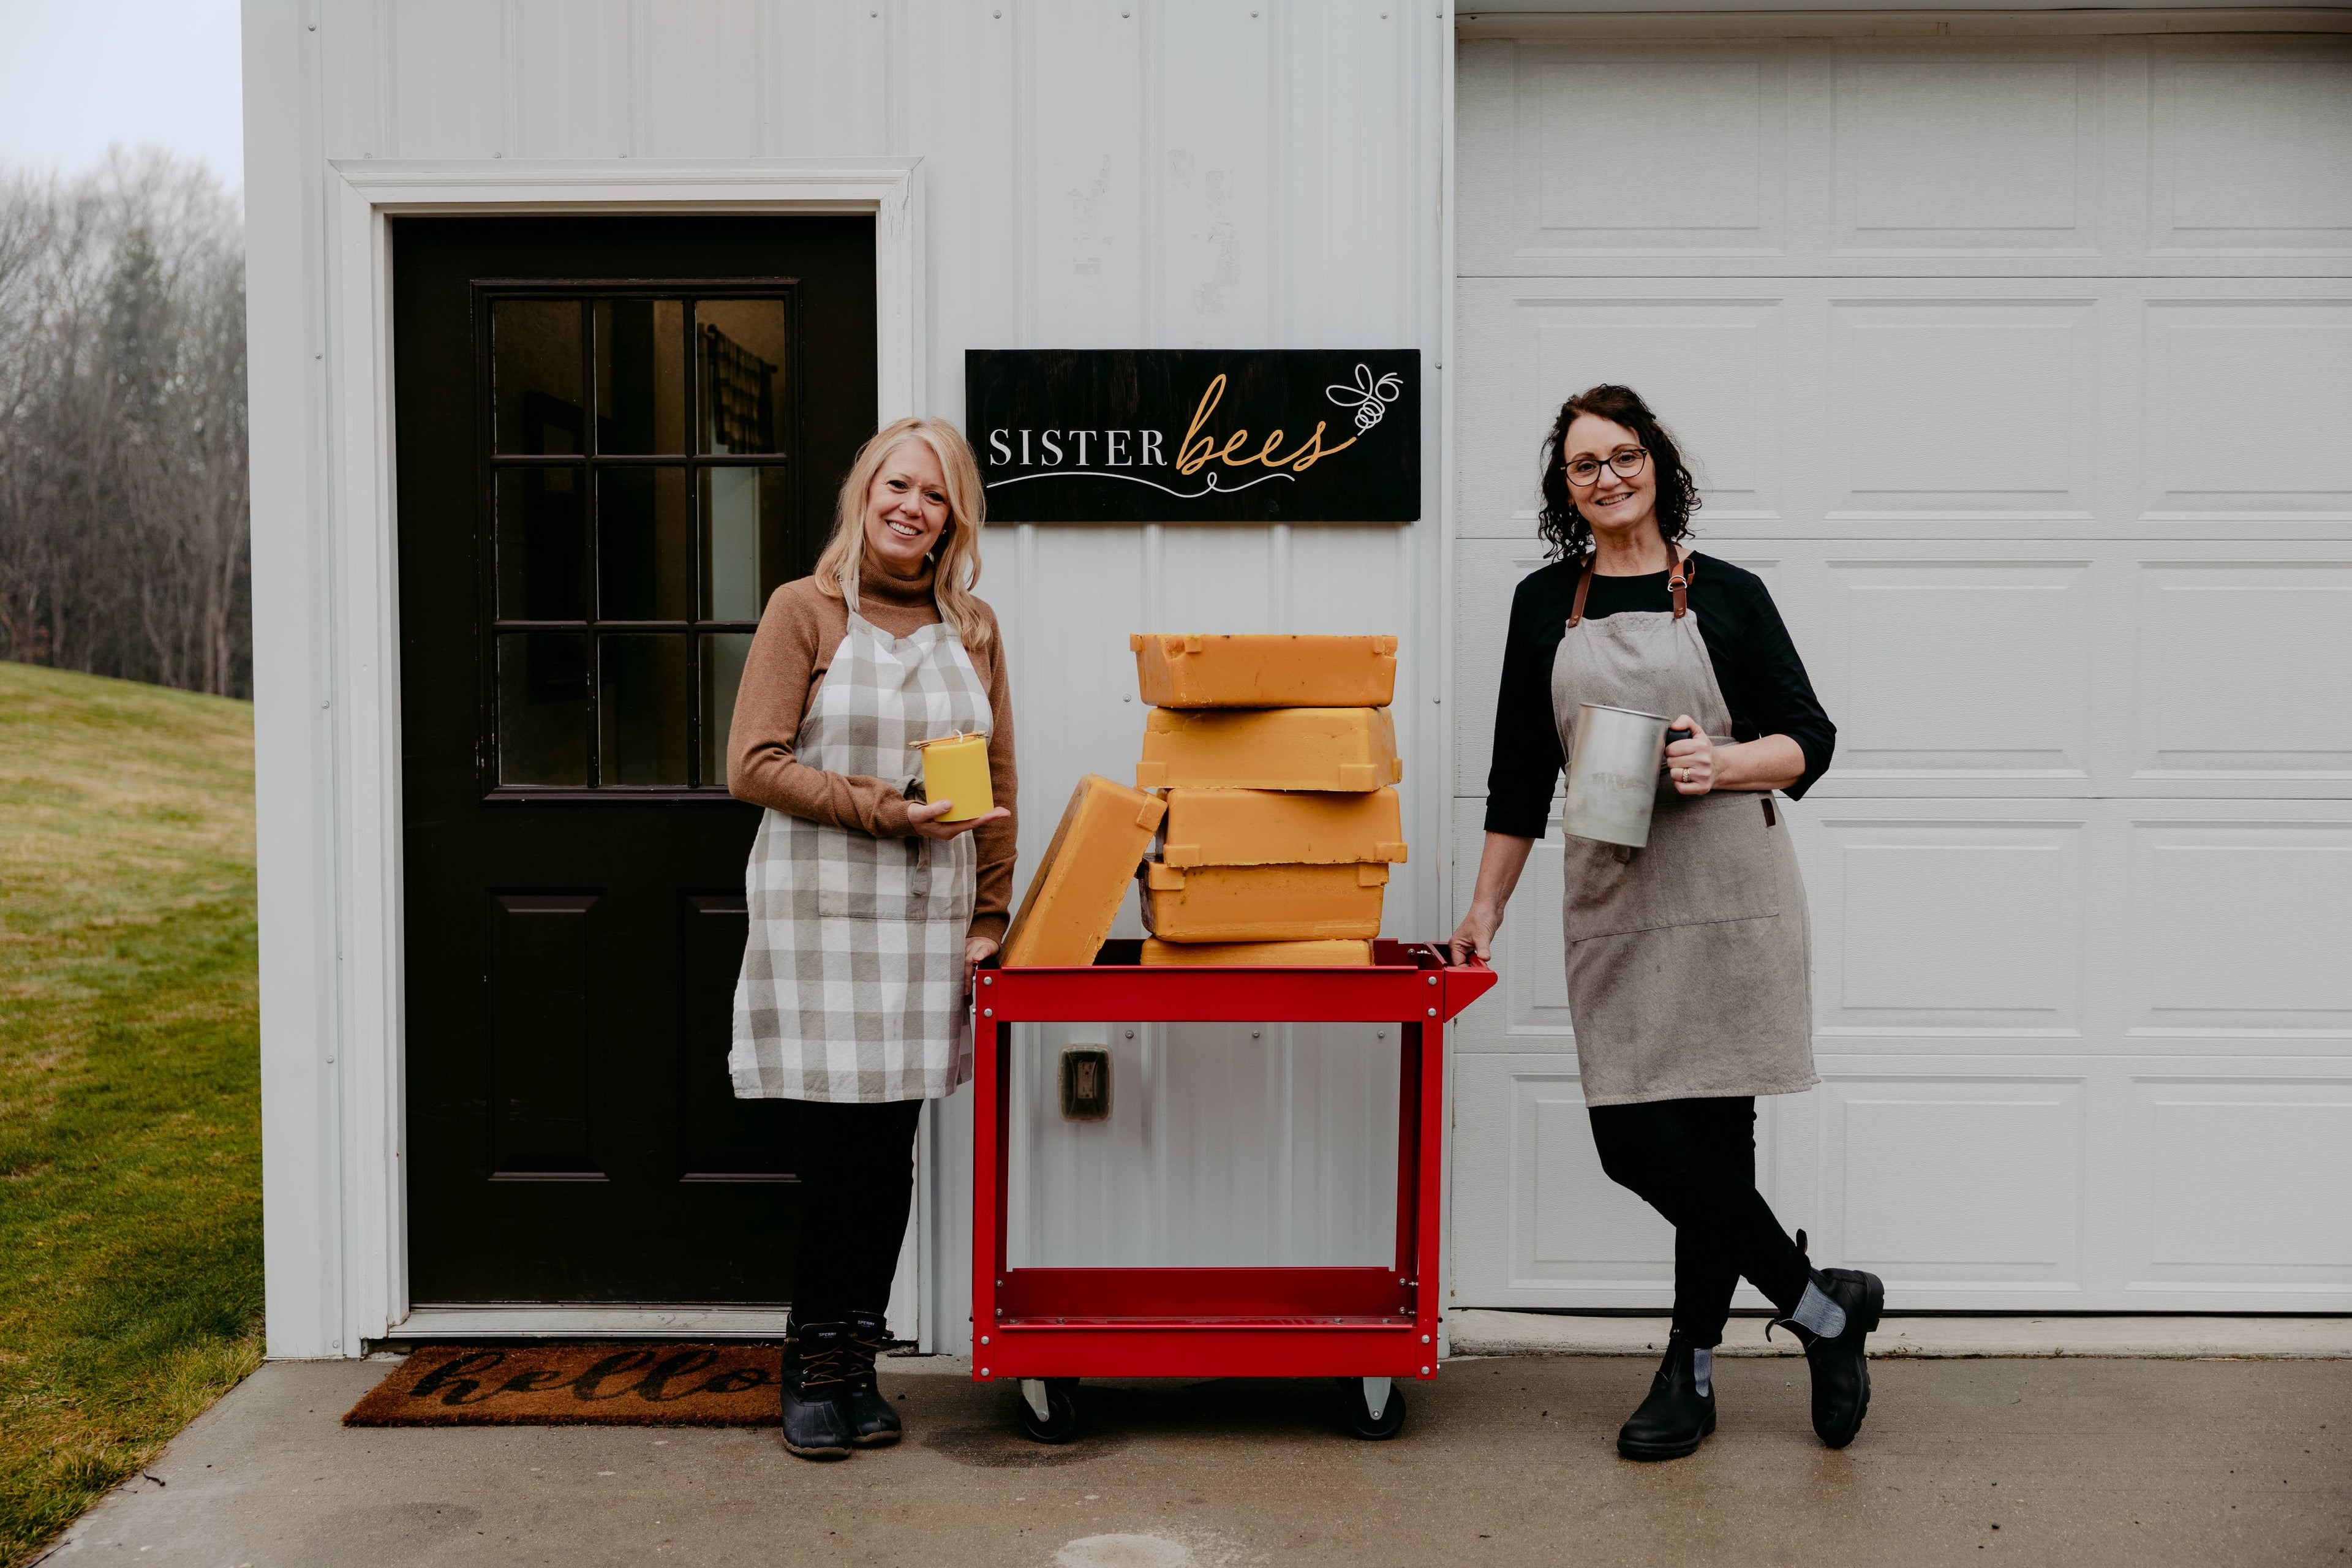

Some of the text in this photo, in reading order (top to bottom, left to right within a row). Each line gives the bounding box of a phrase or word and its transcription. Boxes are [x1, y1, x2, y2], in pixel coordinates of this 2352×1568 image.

[989, 373, 1357, 475] SISTER bees
[410, 1349, 780, 1406] hello
